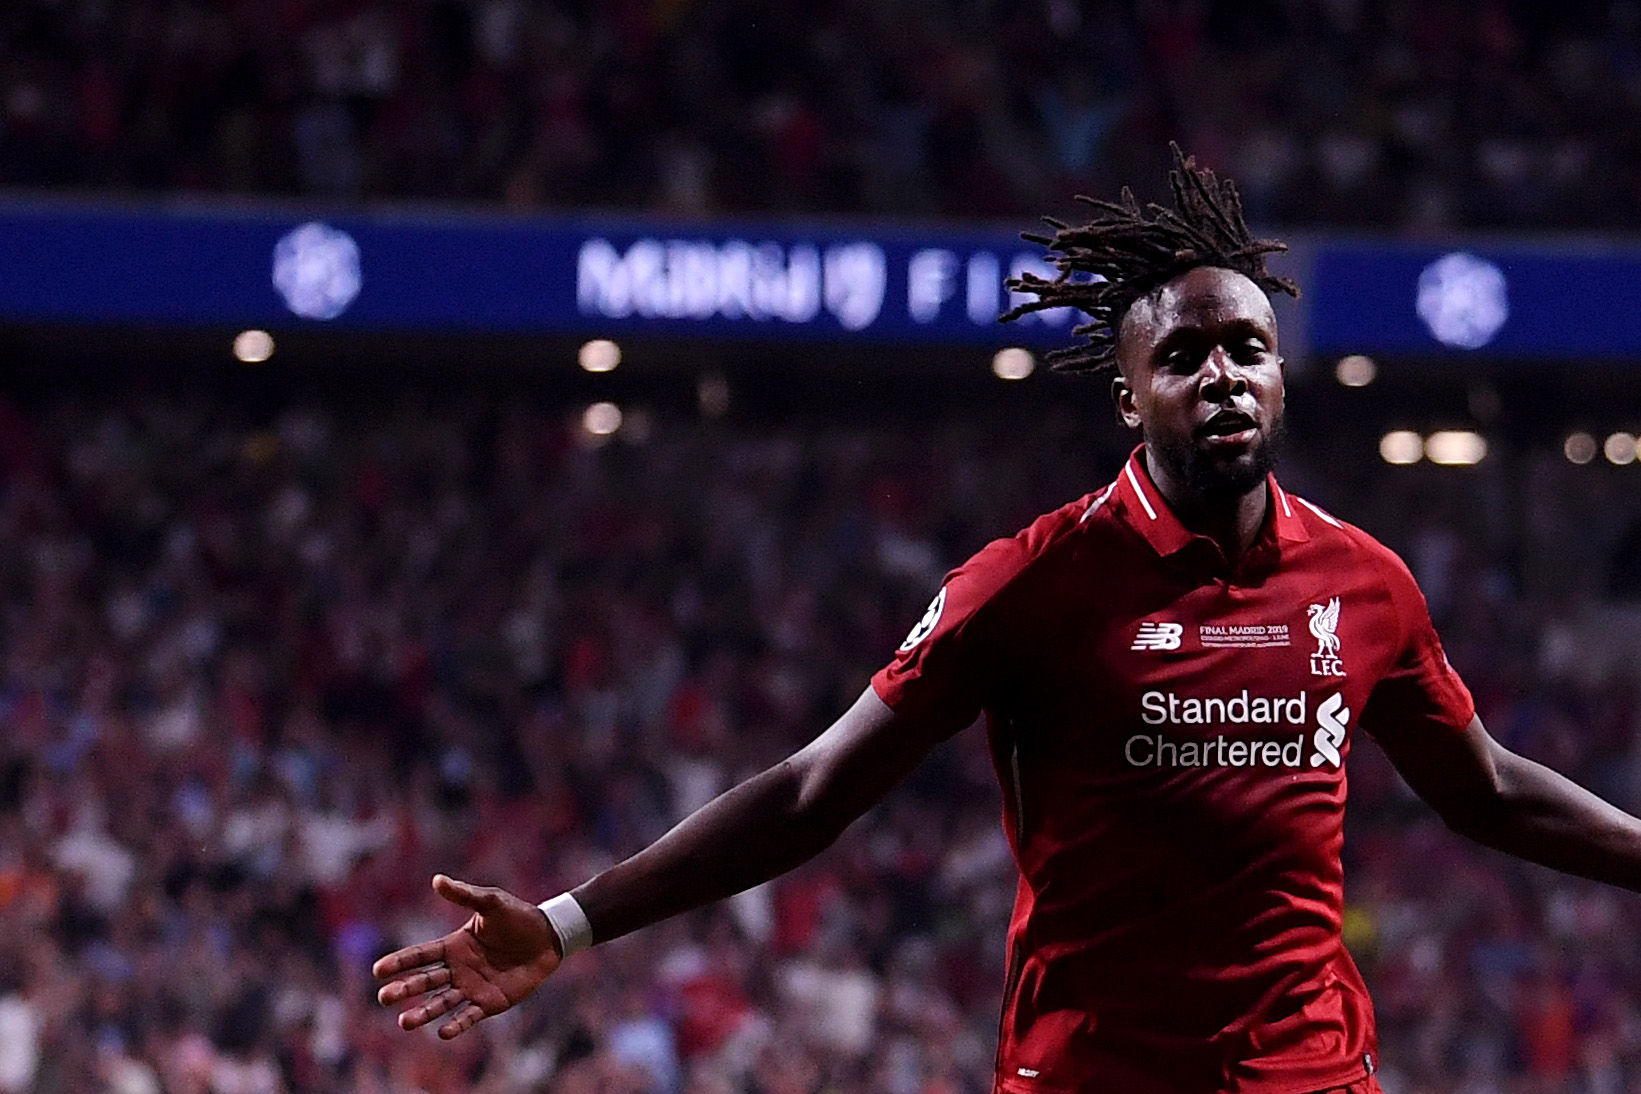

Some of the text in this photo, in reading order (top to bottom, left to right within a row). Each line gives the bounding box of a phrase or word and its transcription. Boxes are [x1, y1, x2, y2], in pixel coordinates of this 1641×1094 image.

[1200, 625, 1228, 635] FINAL
[1229, 625, 1266, 635] MADRID
[1141, 689, 1306, 725] Standard
[1124, 734, 1304, 767] Chartered
